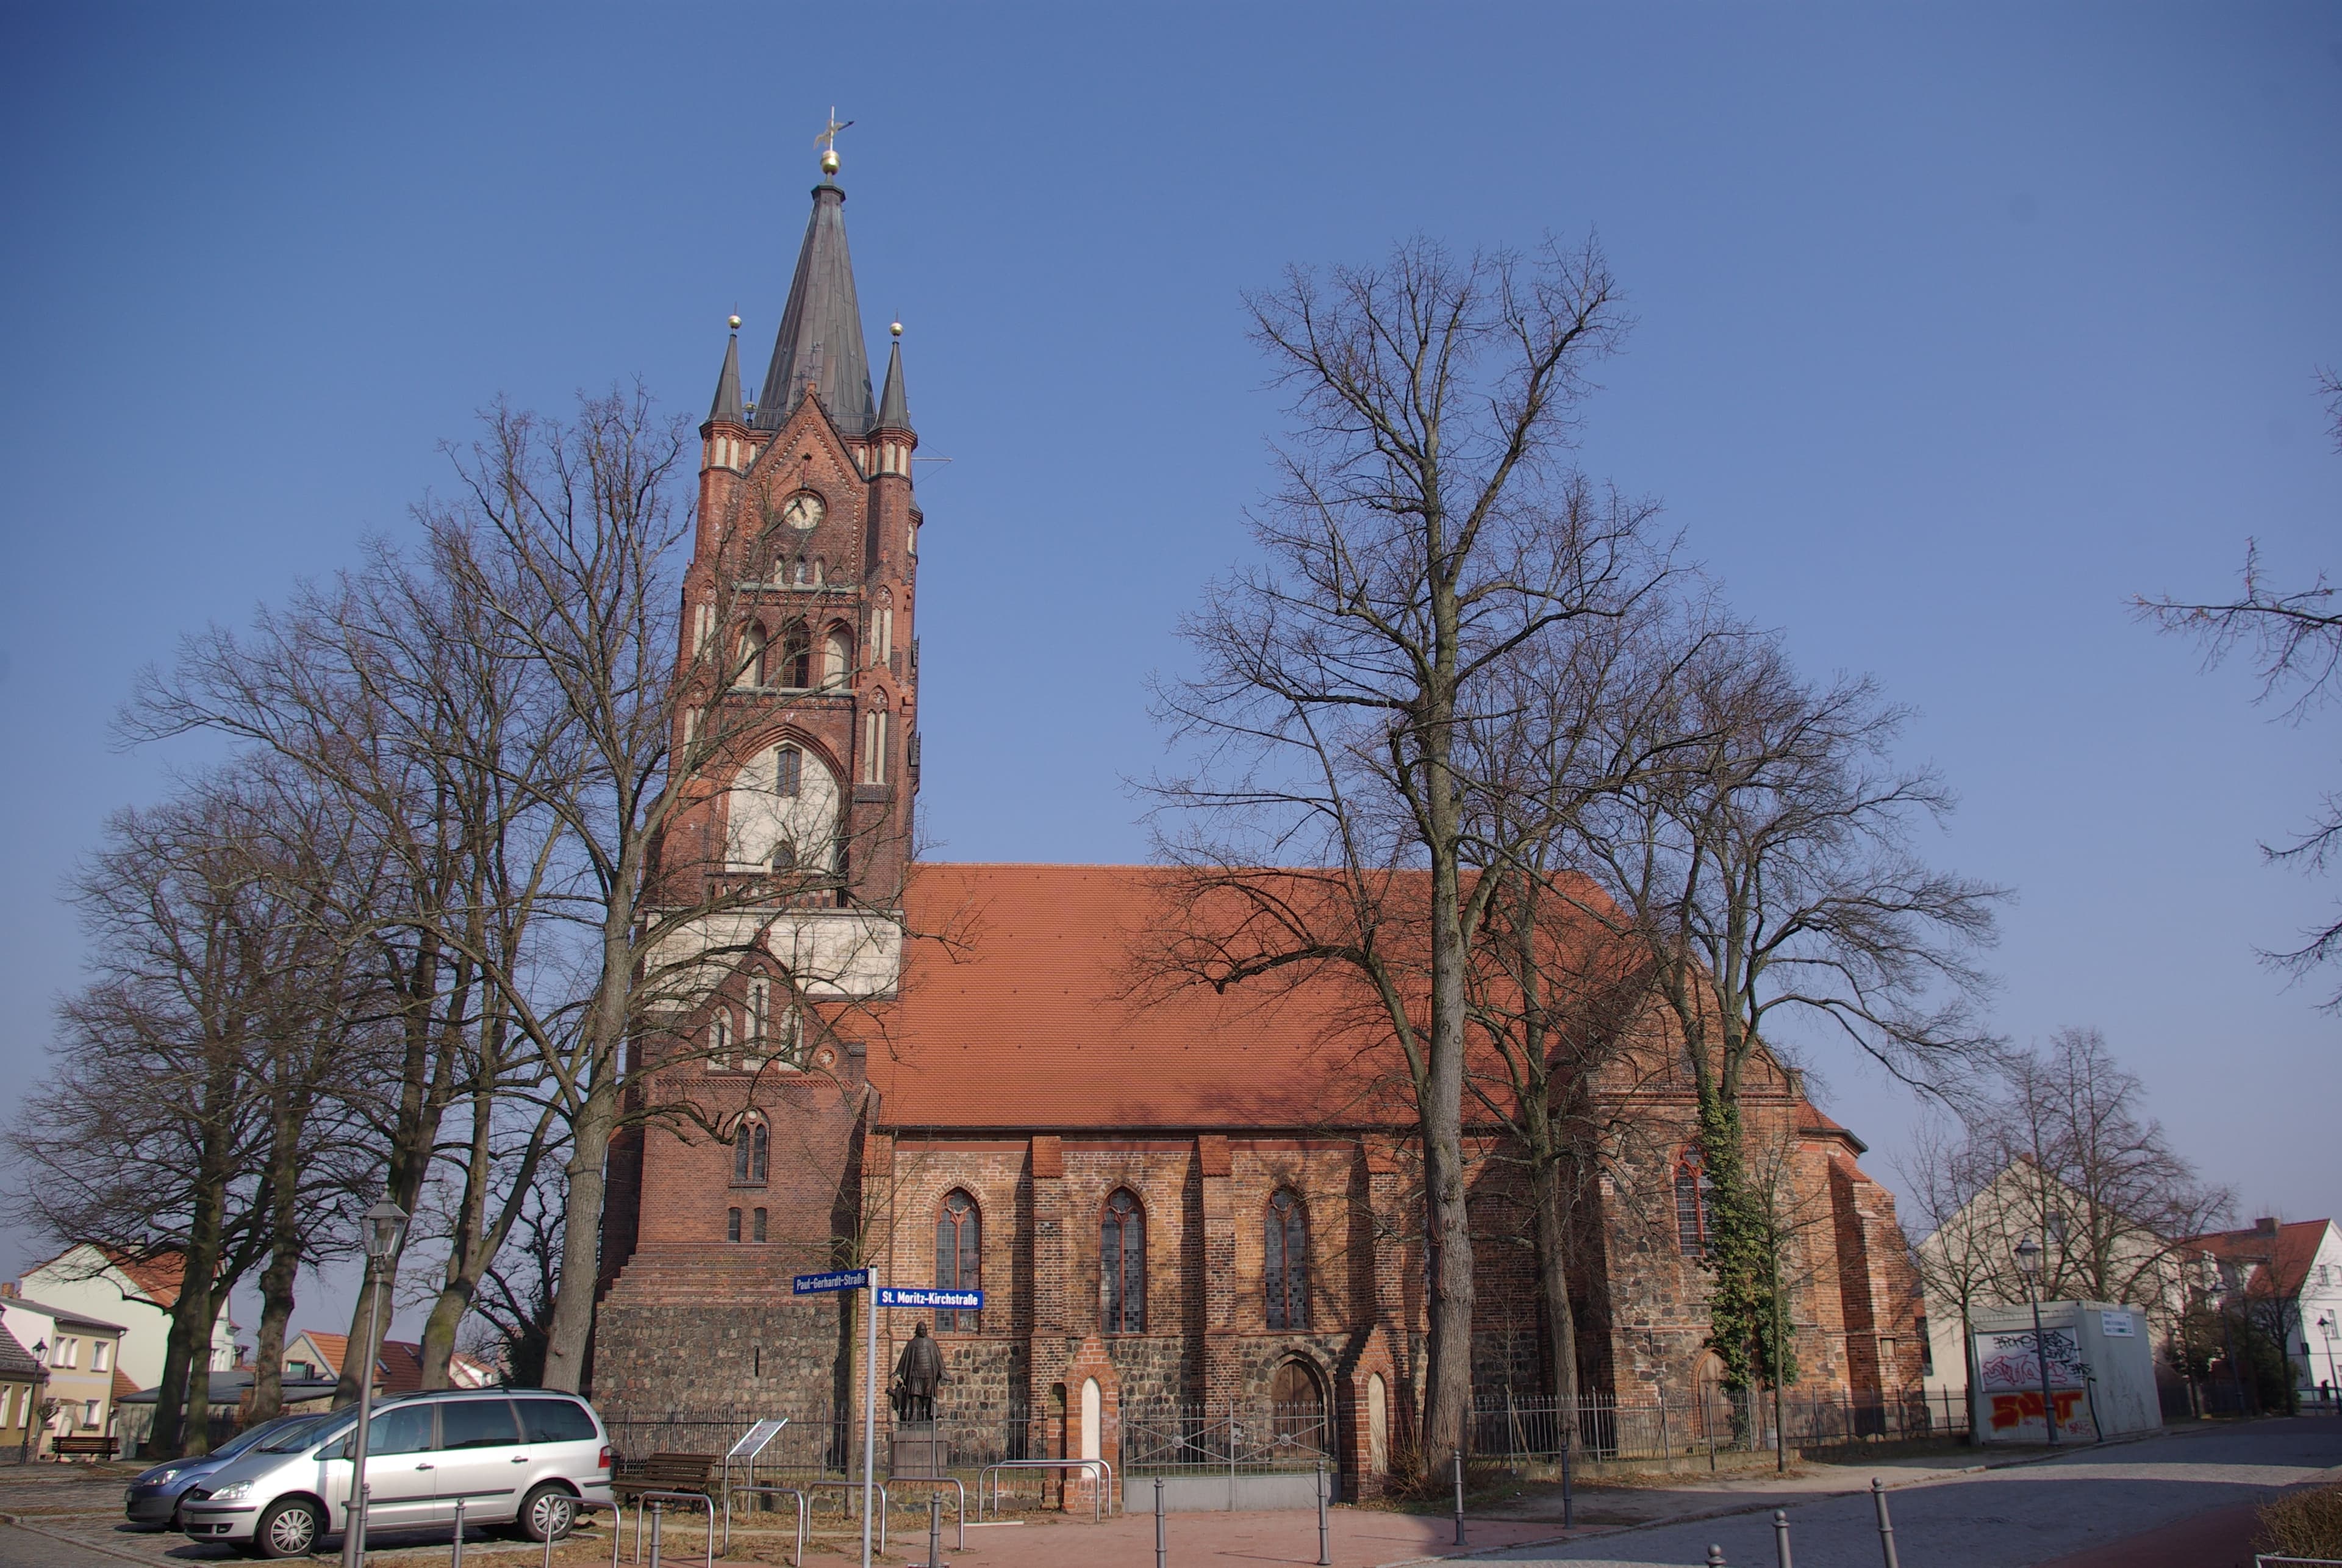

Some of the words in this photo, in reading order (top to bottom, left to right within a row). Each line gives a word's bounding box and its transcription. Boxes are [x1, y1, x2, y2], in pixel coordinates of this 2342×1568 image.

[797, 1273, 865, 1291] Paul-Gerhardt-Straße
[882, 1291, 895, 1303] St.
[897, 1291, 978, 1306] Moritz-Kirchstraße
